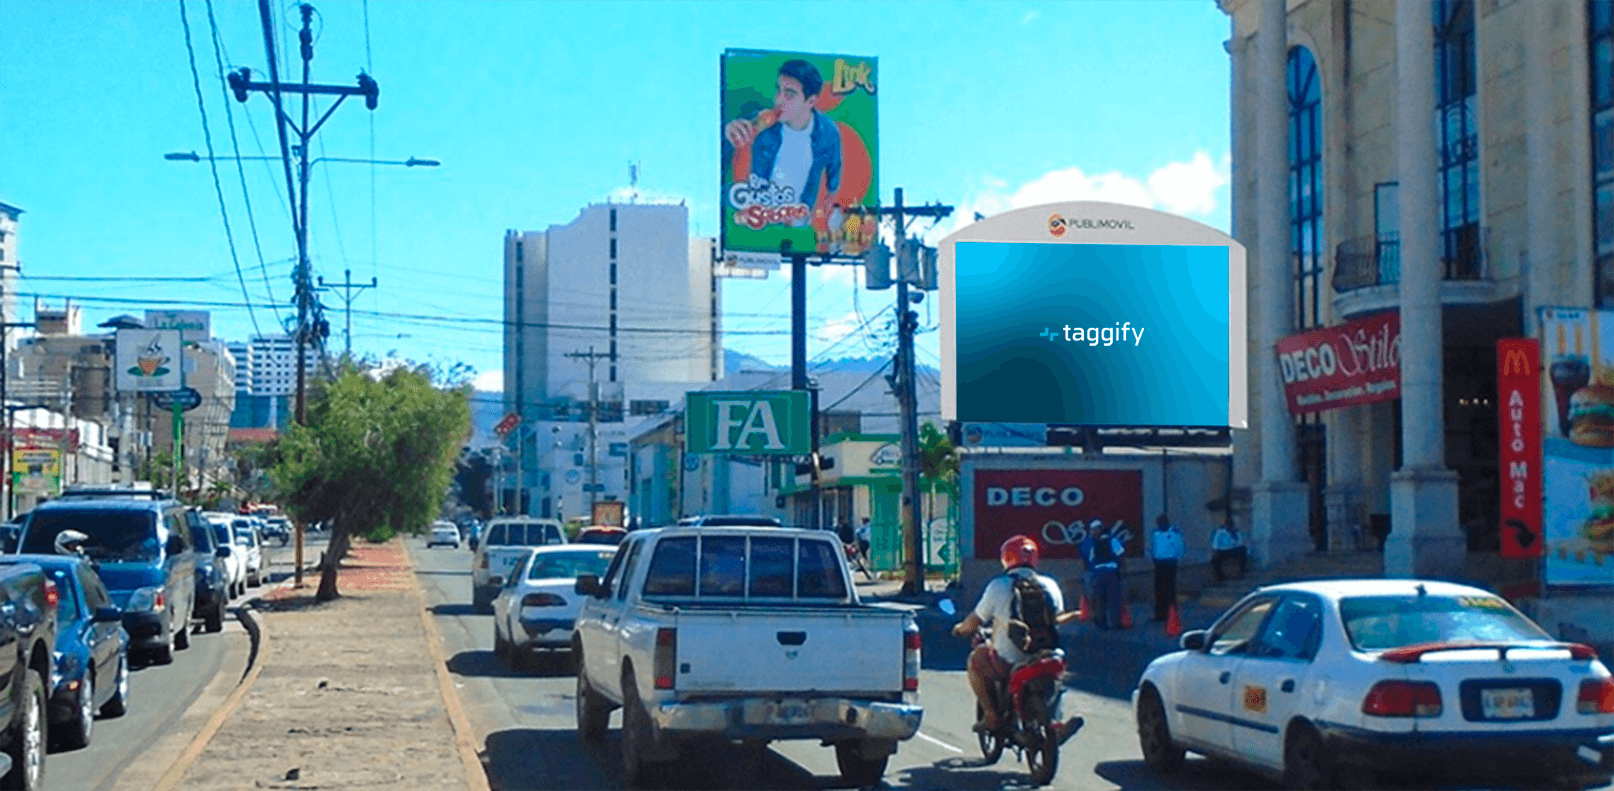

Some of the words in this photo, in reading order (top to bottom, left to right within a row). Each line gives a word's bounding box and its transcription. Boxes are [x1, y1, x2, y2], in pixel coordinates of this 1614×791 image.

[729, 182, 796, 211] Gustos
[1068, 218, 1135, 231] PUBLIMOVIL
[1062, 321, 1145, 346] taggify
[1279, 342, 1337, 384] DECO
[711, 399, 785, 451] FA
[1508, 389, 1524, 452] Auto
[985, 486, 1085, 507] DECO
[1509, 461, 1527, 509] Mac
